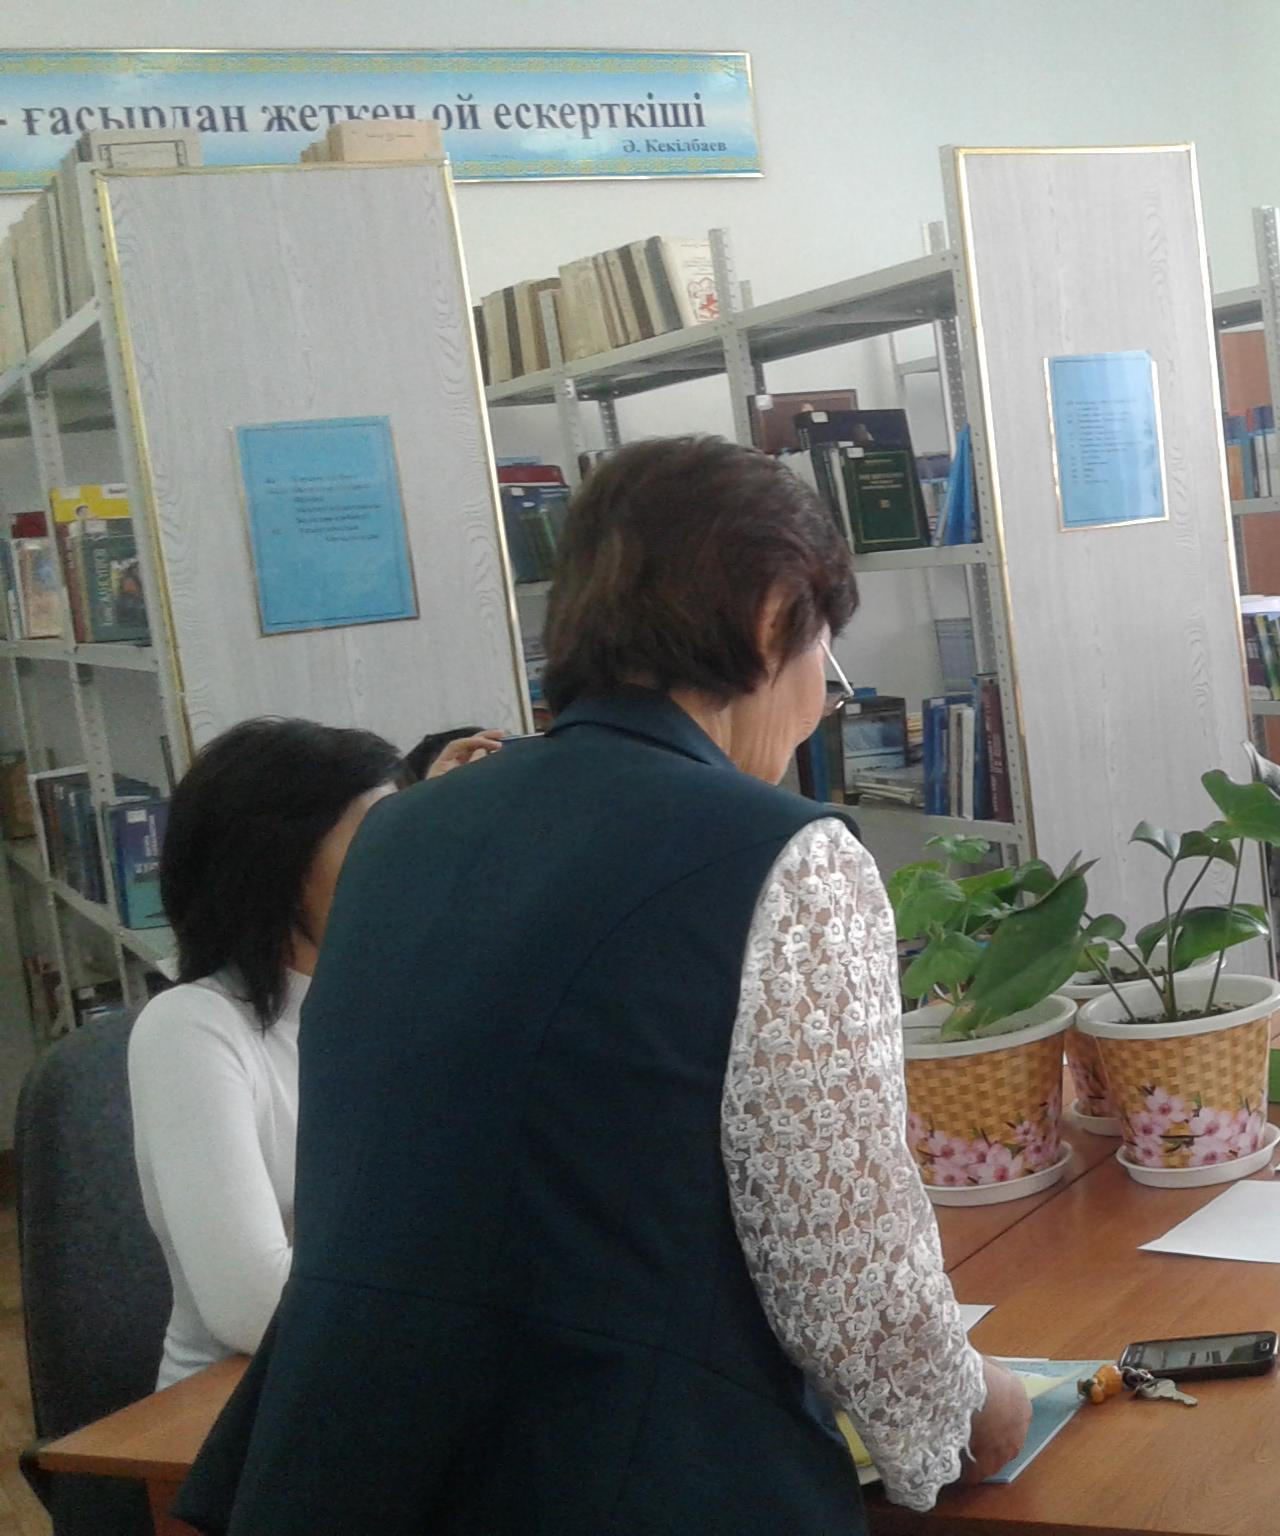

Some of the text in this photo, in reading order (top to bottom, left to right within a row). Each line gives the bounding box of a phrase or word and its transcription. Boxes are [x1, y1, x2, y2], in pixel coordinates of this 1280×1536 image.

[432, 93, 482, 130] ой
[493, 92, 706, 140] ескерткіші
[646, 138, 728, 153] Кекілбаев
